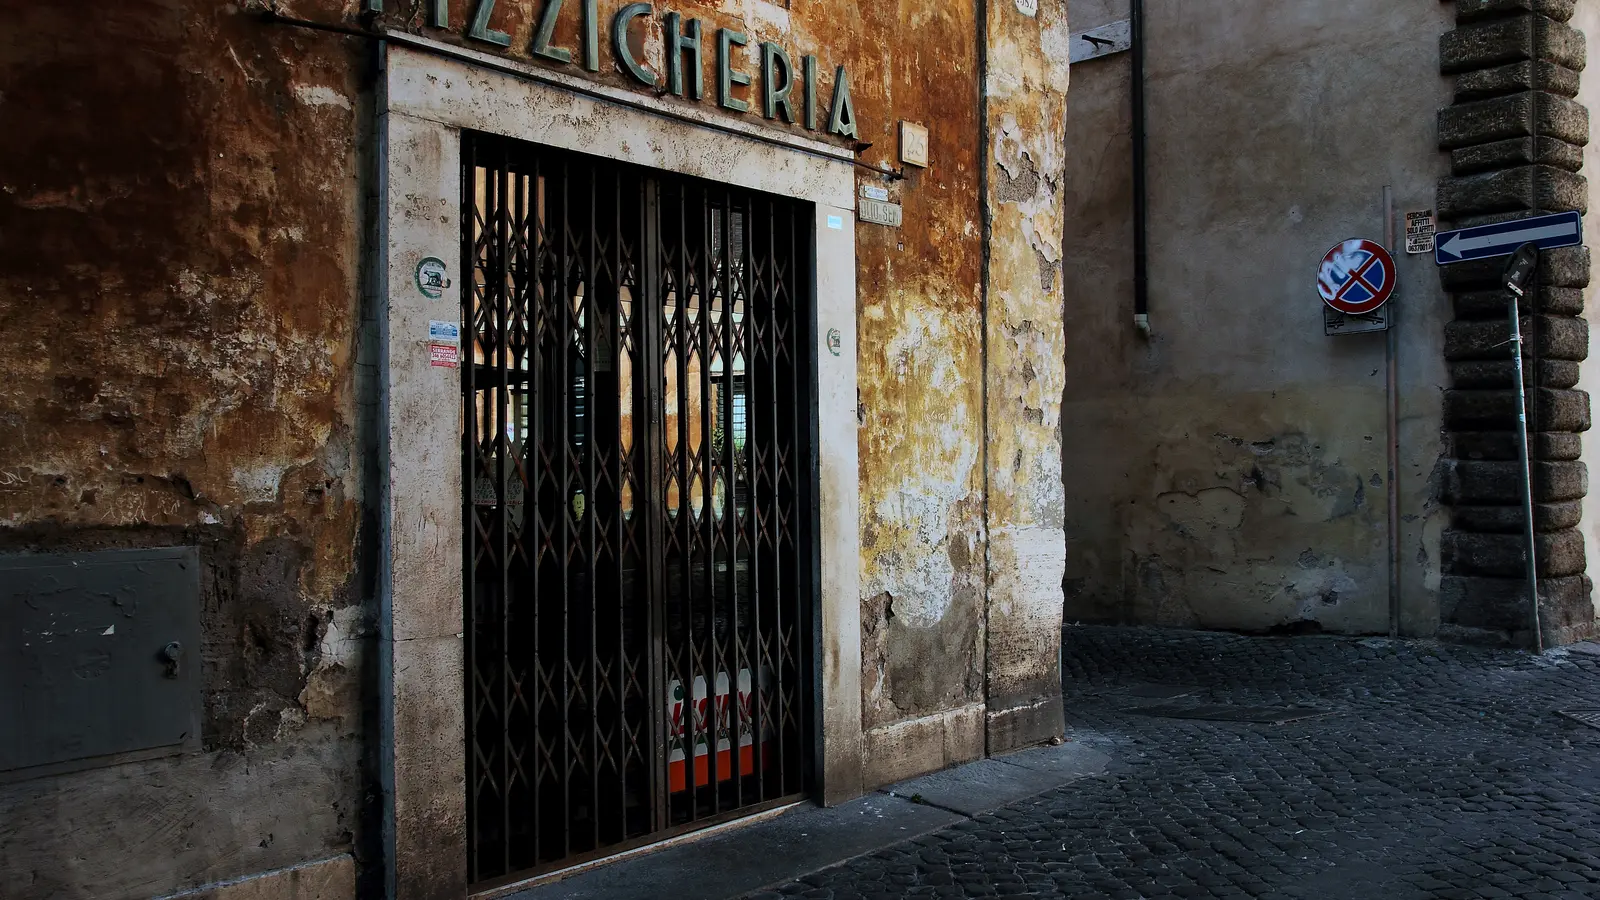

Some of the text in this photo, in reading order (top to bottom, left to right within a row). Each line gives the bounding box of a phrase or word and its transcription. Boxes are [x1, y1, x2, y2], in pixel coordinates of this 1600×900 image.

[367, 0, 859, 140] ZZICHERIA
[906, 131, 924, 156] 25
[1411, 218, 1430, 226] AFFITTI
[1419, 224, 1434, 233] AFFITTI
